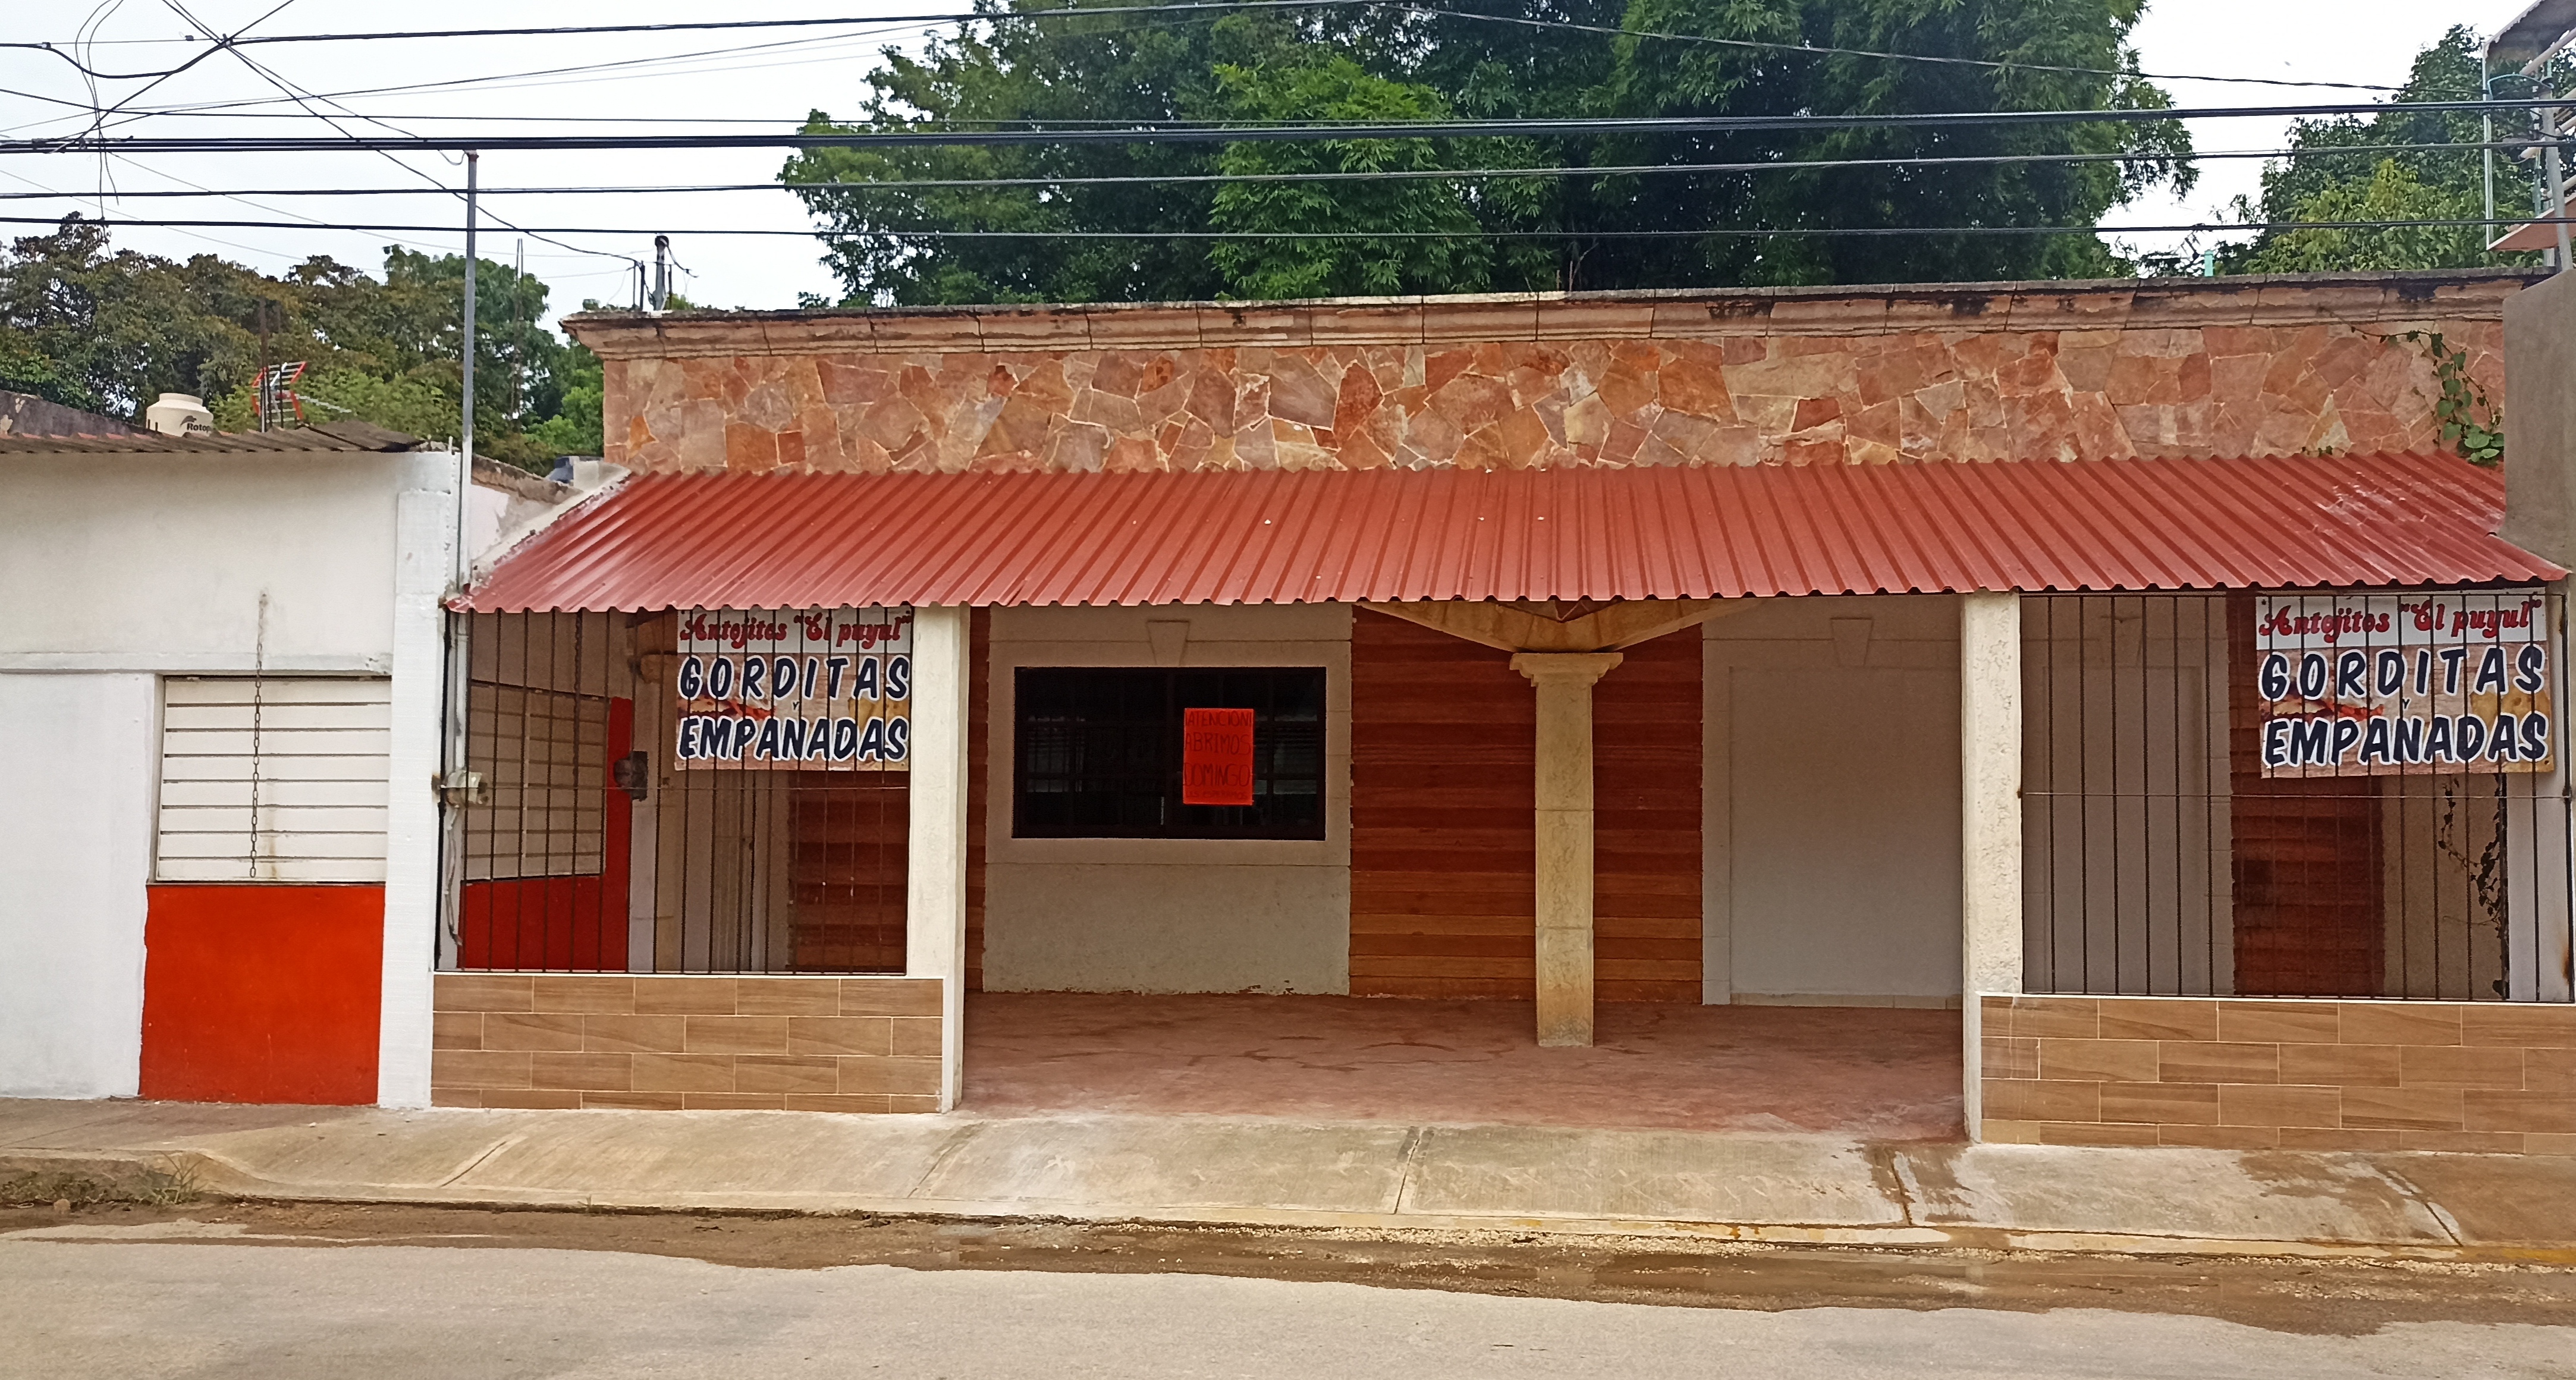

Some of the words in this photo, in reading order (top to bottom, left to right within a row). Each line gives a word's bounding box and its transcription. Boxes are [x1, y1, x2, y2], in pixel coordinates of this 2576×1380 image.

[680, 613, 788, 649] Antojitos
[2259, 605, 2390, 643] Antojitos
[678, 655, 910, 700] GORDITAS
[2259, 643, 2546, 701] GORDITAS
[793, 701, 800, 711] Y
[2401, 698, 2411, 709] Y
[677, 716, 909, 762] EMPANADAS
[1185, 731, 1252, 756] ABRIMOS
[2261, 712, 2548, 768] EMPANADAS
[1183, 762, 1251, 787] DOMINGO
